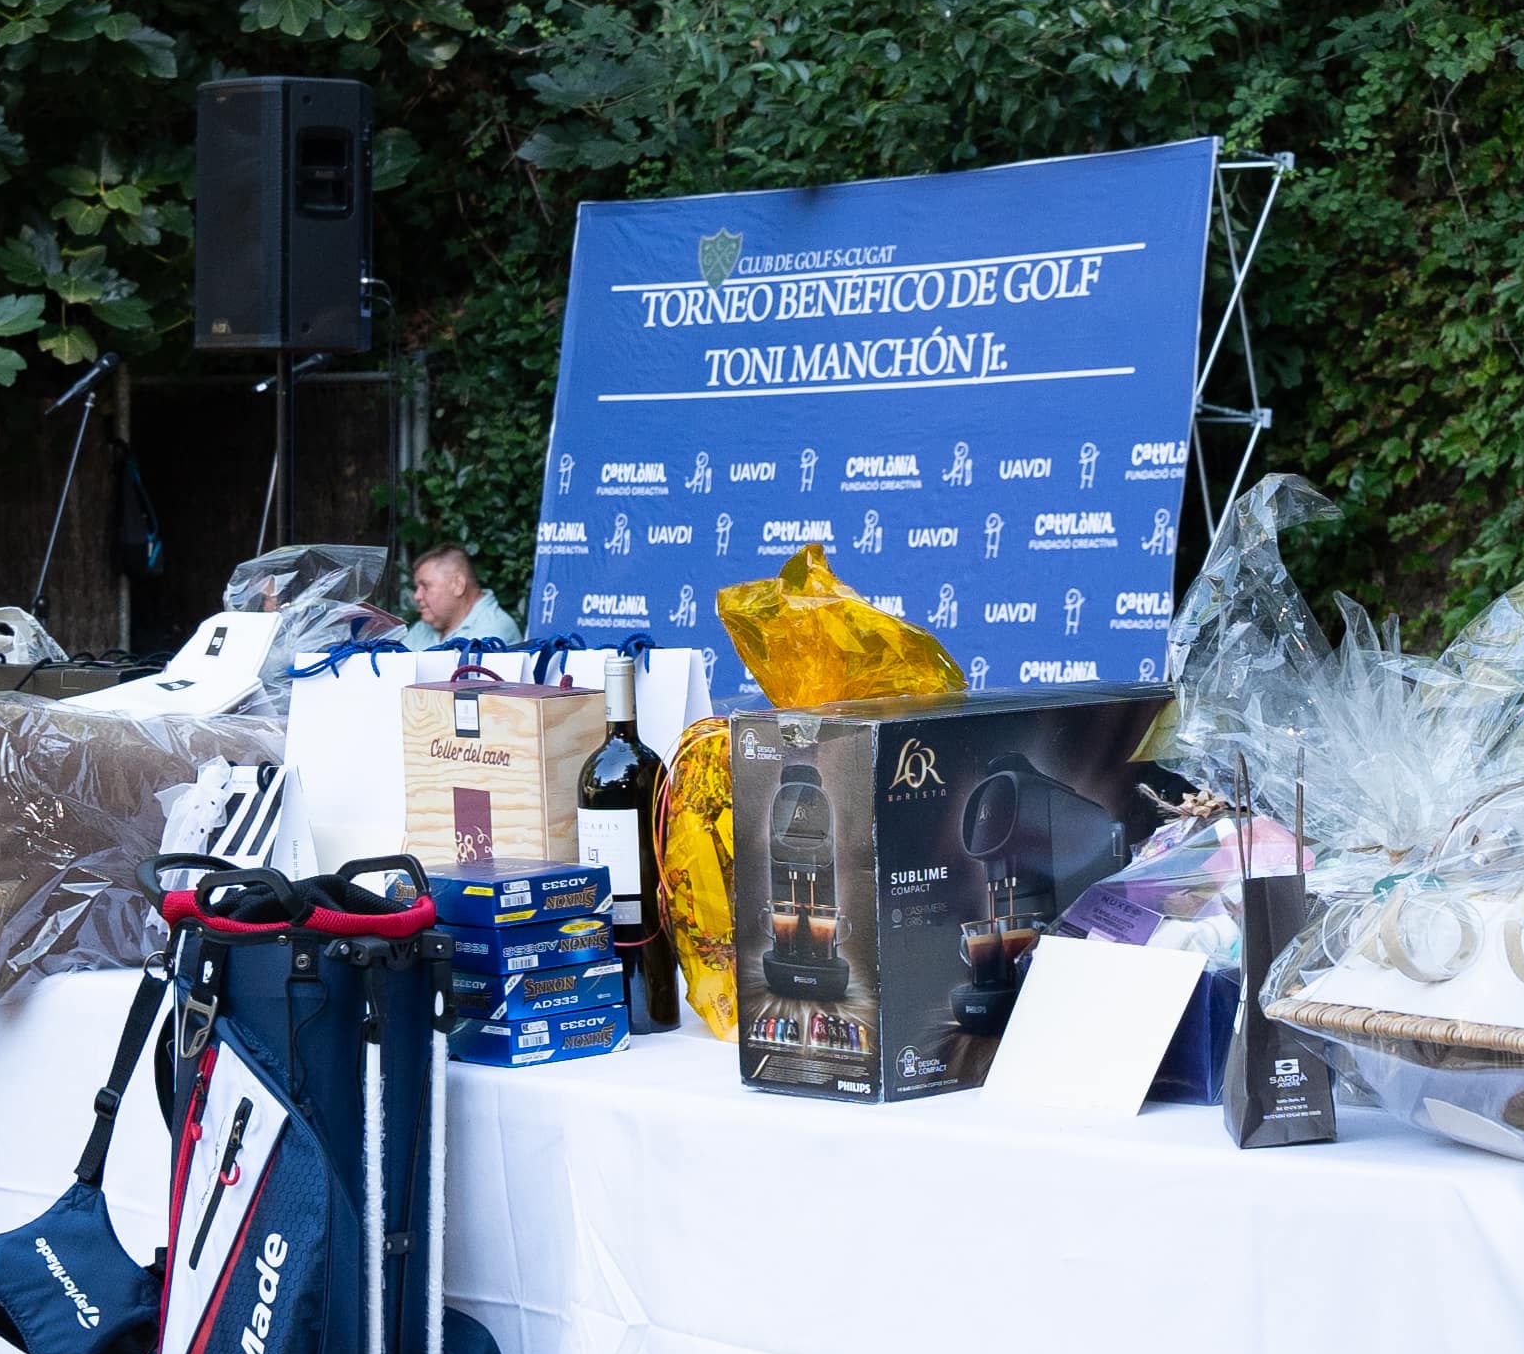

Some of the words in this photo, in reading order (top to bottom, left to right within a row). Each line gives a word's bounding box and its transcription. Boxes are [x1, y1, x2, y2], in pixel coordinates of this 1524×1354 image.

[738, 256, 773, 275] CLUB
[776, 253, 793, 271] DE
[794, 249, 834, 270] GOLF
[845, 244, 898, 266] CUGAT
[642, 283, 774, 328] TORNEO
[775, 272, 946, 321] BENÉFICO
[947, 266, 999, 309] DE
[1003, 256, 1103, 304] GOLF
[705, 346, 786, 387] TONI
[788, 326, 979, 384] MANCHÓN
[978, 332, 1009, 379] Jr.
[730, 461, 776, 483] UAVDI
[999, 458, 1052, 479] UAVDI
[648, 525, 693, 544] UAVDI
[907, 527, 959, 549] UAVDI
[984, 602, 1037, 624] UAVDI
[430, 739, 461, 760] Celler
[463, 742, 481, 764] del
[541, 876, 588, 891] AD333
[890, 866, 948, 885] SUBLIME
[890, 884, 931, 896] COMPACT
[523, 975, 576, 1004] SRIXON
[532, 996, 579, 1010] AD333
[560, 1016, 607, 1031] AD333
[917, 1058, 940, 1068] DESIGN
[918, 1064, 947, 1075] COMPACT
[837, 1080, 871, 1094] PHILIPS
[33, 1235, 101, 1330] TaylorMade
